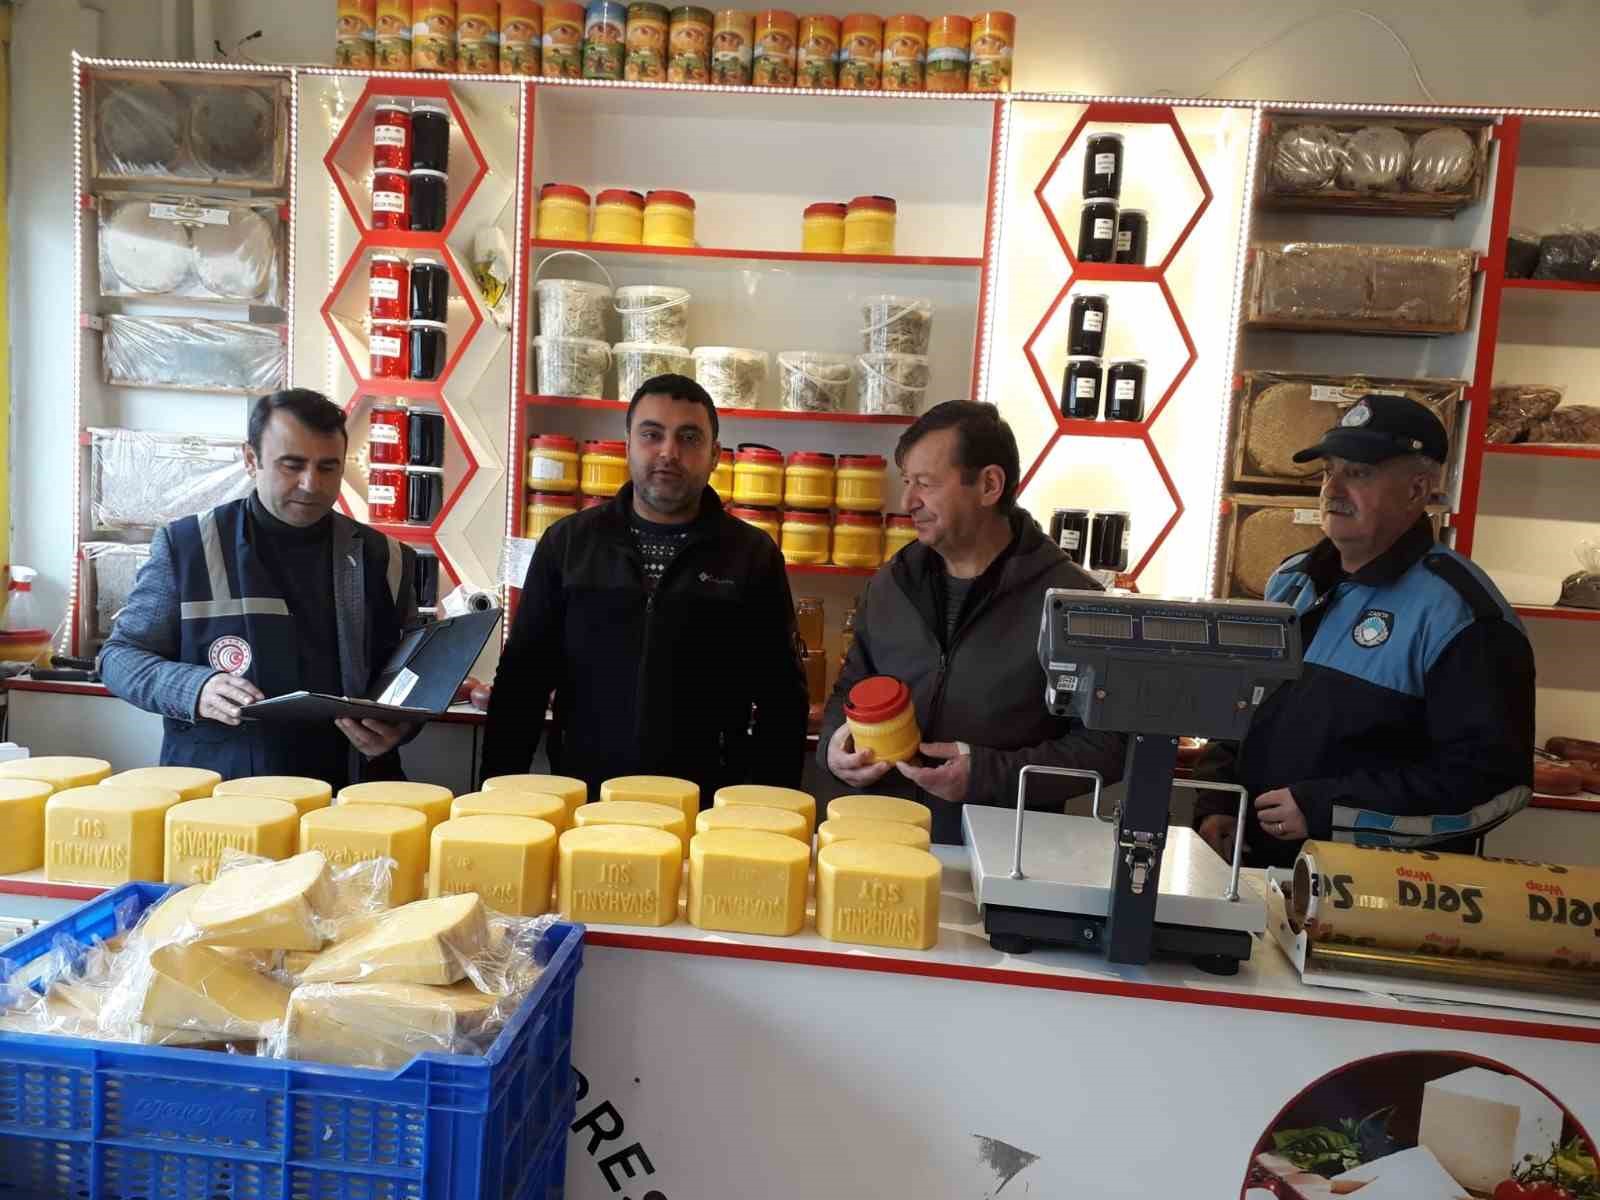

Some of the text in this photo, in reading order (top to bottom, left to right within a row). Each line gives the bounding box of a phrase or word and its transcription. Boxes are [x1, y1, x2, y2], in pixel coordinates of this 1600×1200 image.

[1395, 866, 1434, 883] Wrap
[1525, 880, 1564, 897] Wrap
[1397, 879, 1484, 924] Sera
